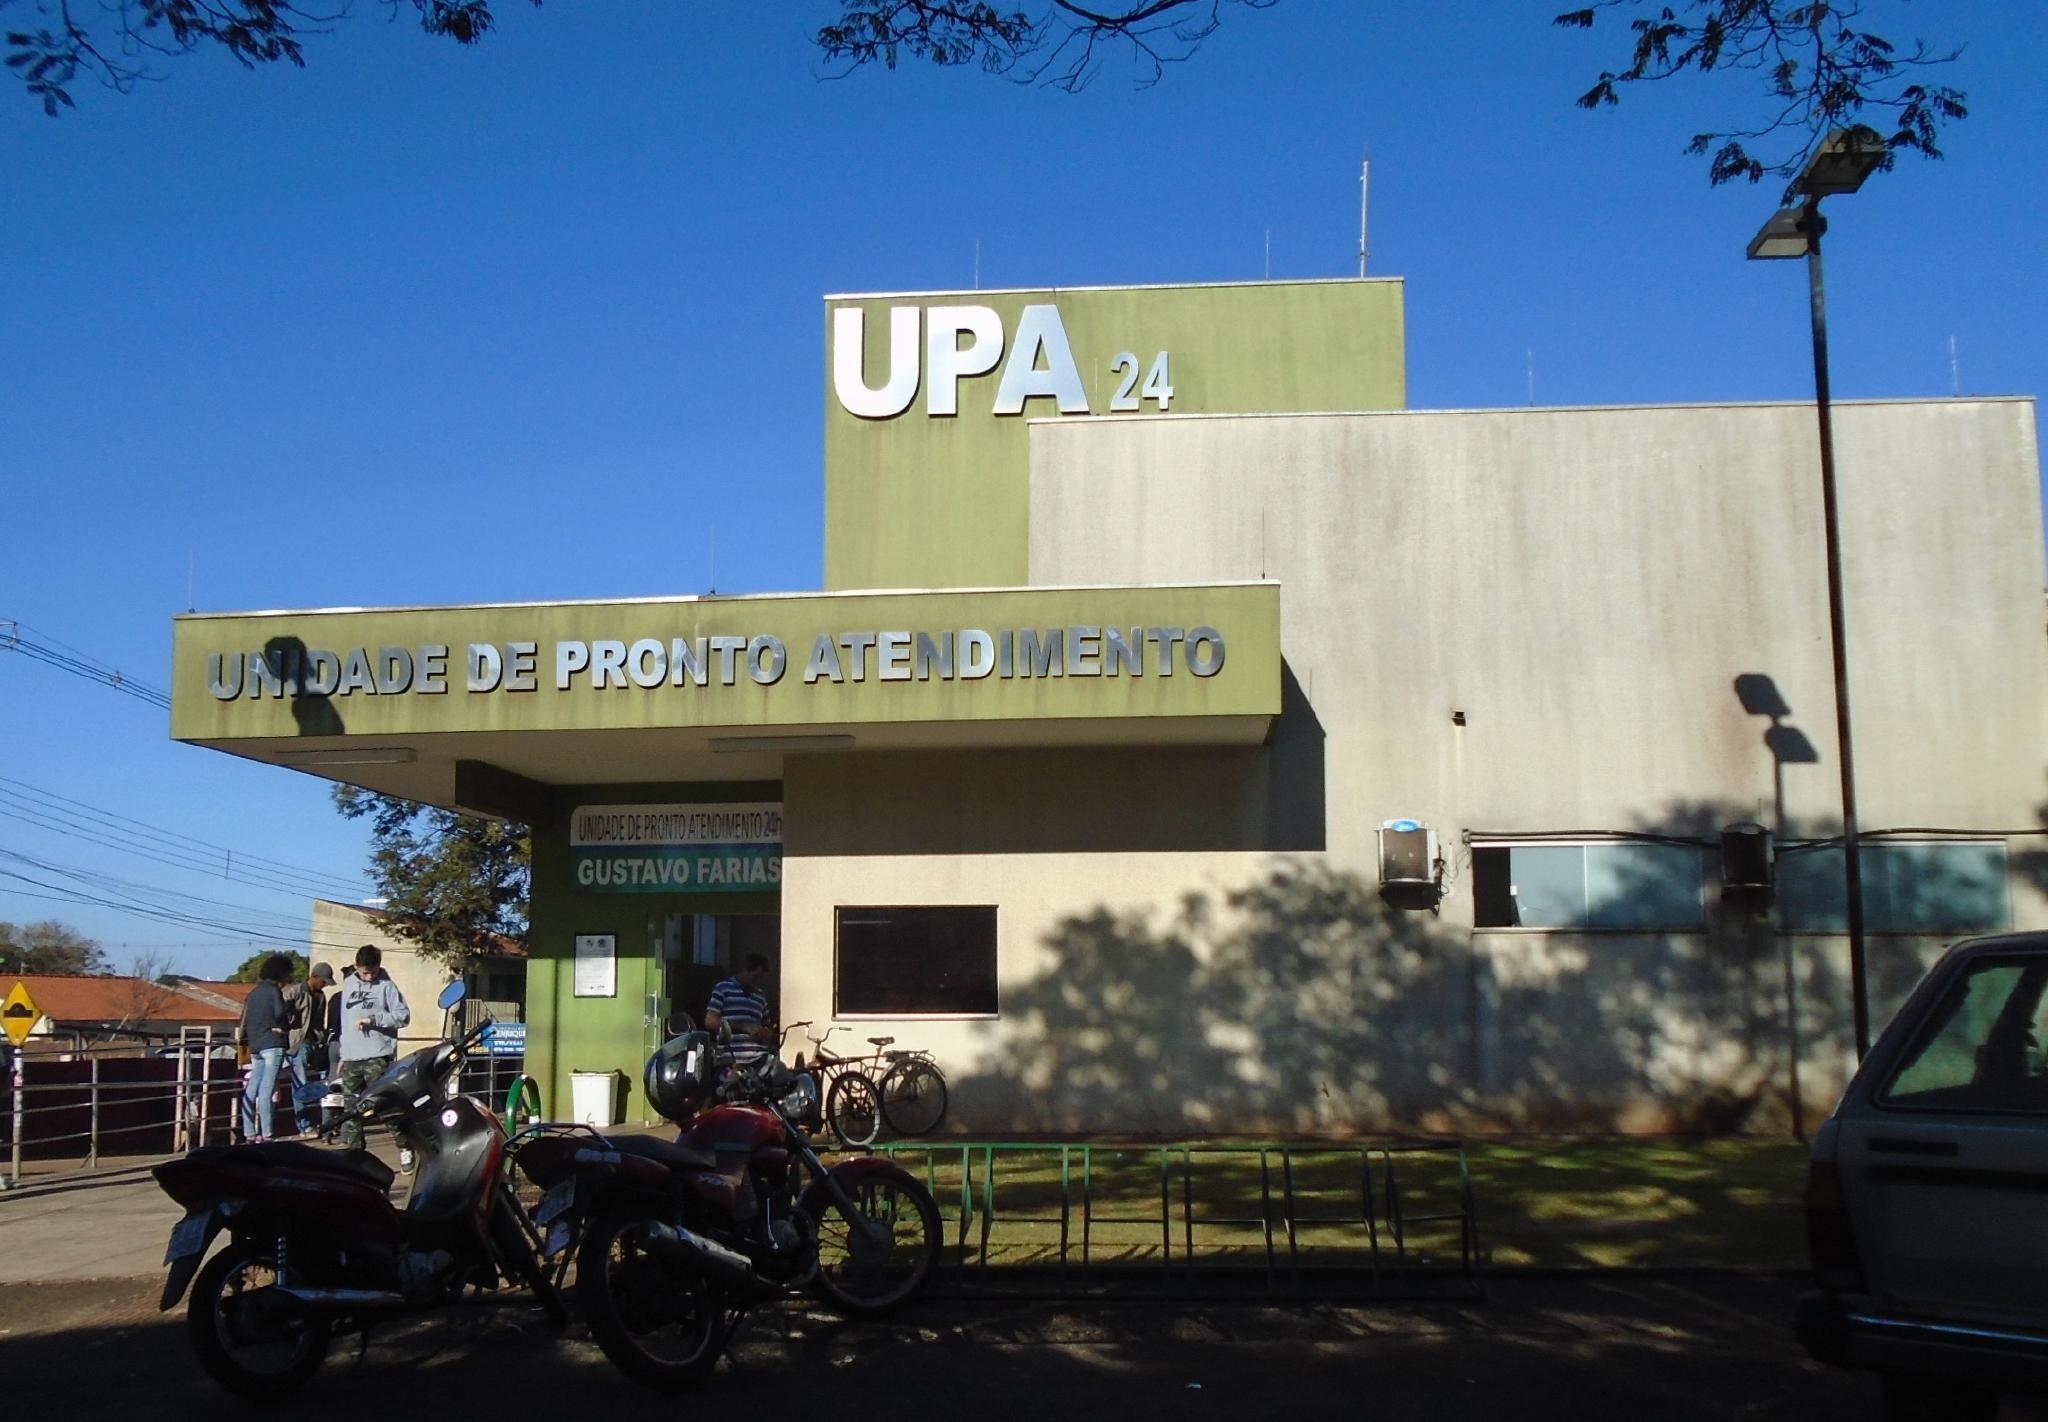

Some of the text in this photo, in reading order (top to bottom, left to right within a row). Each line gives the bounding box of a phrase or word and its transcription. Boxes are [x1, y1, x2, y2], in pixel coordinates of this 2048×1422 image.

[833, 304, 1174, 418] UPA 24
[207, 626, 1226, 701] UNIDADE DE PRONTO ATENDIMENTO
[578, 814, 626, 842] UNIDADE
[628, 814, 642, 841] DE
[644, 813, 687, 841] PRONTO
[688, 812, 763, 840] ATENDIMENTO
[577, 856, 782, 886] GUSTAVO FARIAS
